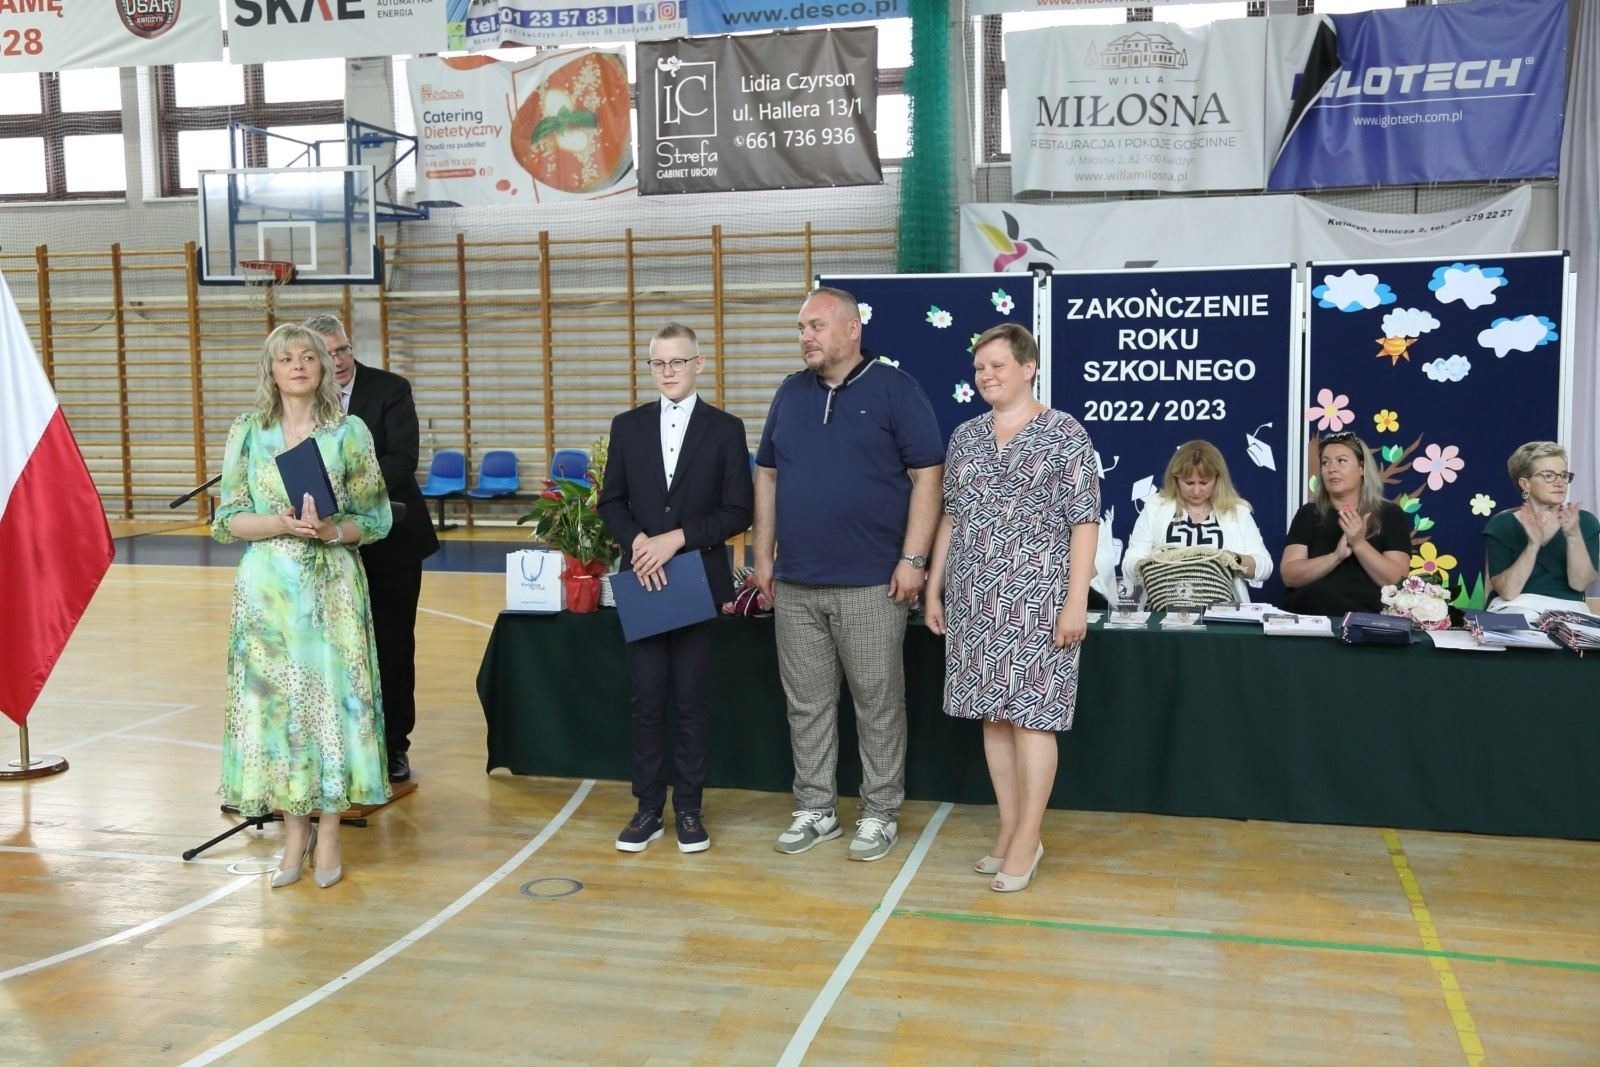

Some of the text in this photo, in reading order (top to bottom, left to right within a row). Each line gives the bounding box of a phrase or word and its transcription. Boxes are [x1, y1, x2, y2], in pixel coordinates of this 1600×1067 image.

[377, 9, 413, 18] ENERGIA
[470, 16, 500, 34] tel.
[529, 11, 553, 27] 23
[558, 10, 580, 26] 57
[586, 8, 609, 25] 83
[722, 0, 898, 25] www.desco.pl
[0, 28, 44, 56] 28
[741, 72, 855, 93] Lidia Czyrson
[1108, 76, 1165, 86] WILLA
[1318, 57, 1522, 99] LOTECH
[423, 108, 483, 124] Catering
[733, 97, 863, 122] ul. Hallera 13/1
[1036, 92, 1231, 128] MIŁOSNA
[1353, 110, 1463, 129] www.iglotech.com.pl
[424, 124, 503, 139] Dietetyczny
[746, 127, 856, 149] 661 736 936
[656, 140, 718, 168] Strefa
[1030, 138, 1115, 151] RESTAURACJA
[1124, 138, 1171, 150] POKOJE
[1174, 136, 1237, 151] GOŚCINNE
[656, 167, 718, 179] GABINET URODY
[1074, 168, 1188, 182] www.willamilosna.pl
[1485, 211, 1499, 220] 22
[1500, 209, 1513, 218] 27
[1066, 288, 1269, 320] ZAKOŃCZENIE
[1118, 328, 1199, 350] ROKU
[1083, 359, 1256, 382] SZKOLNEGO
